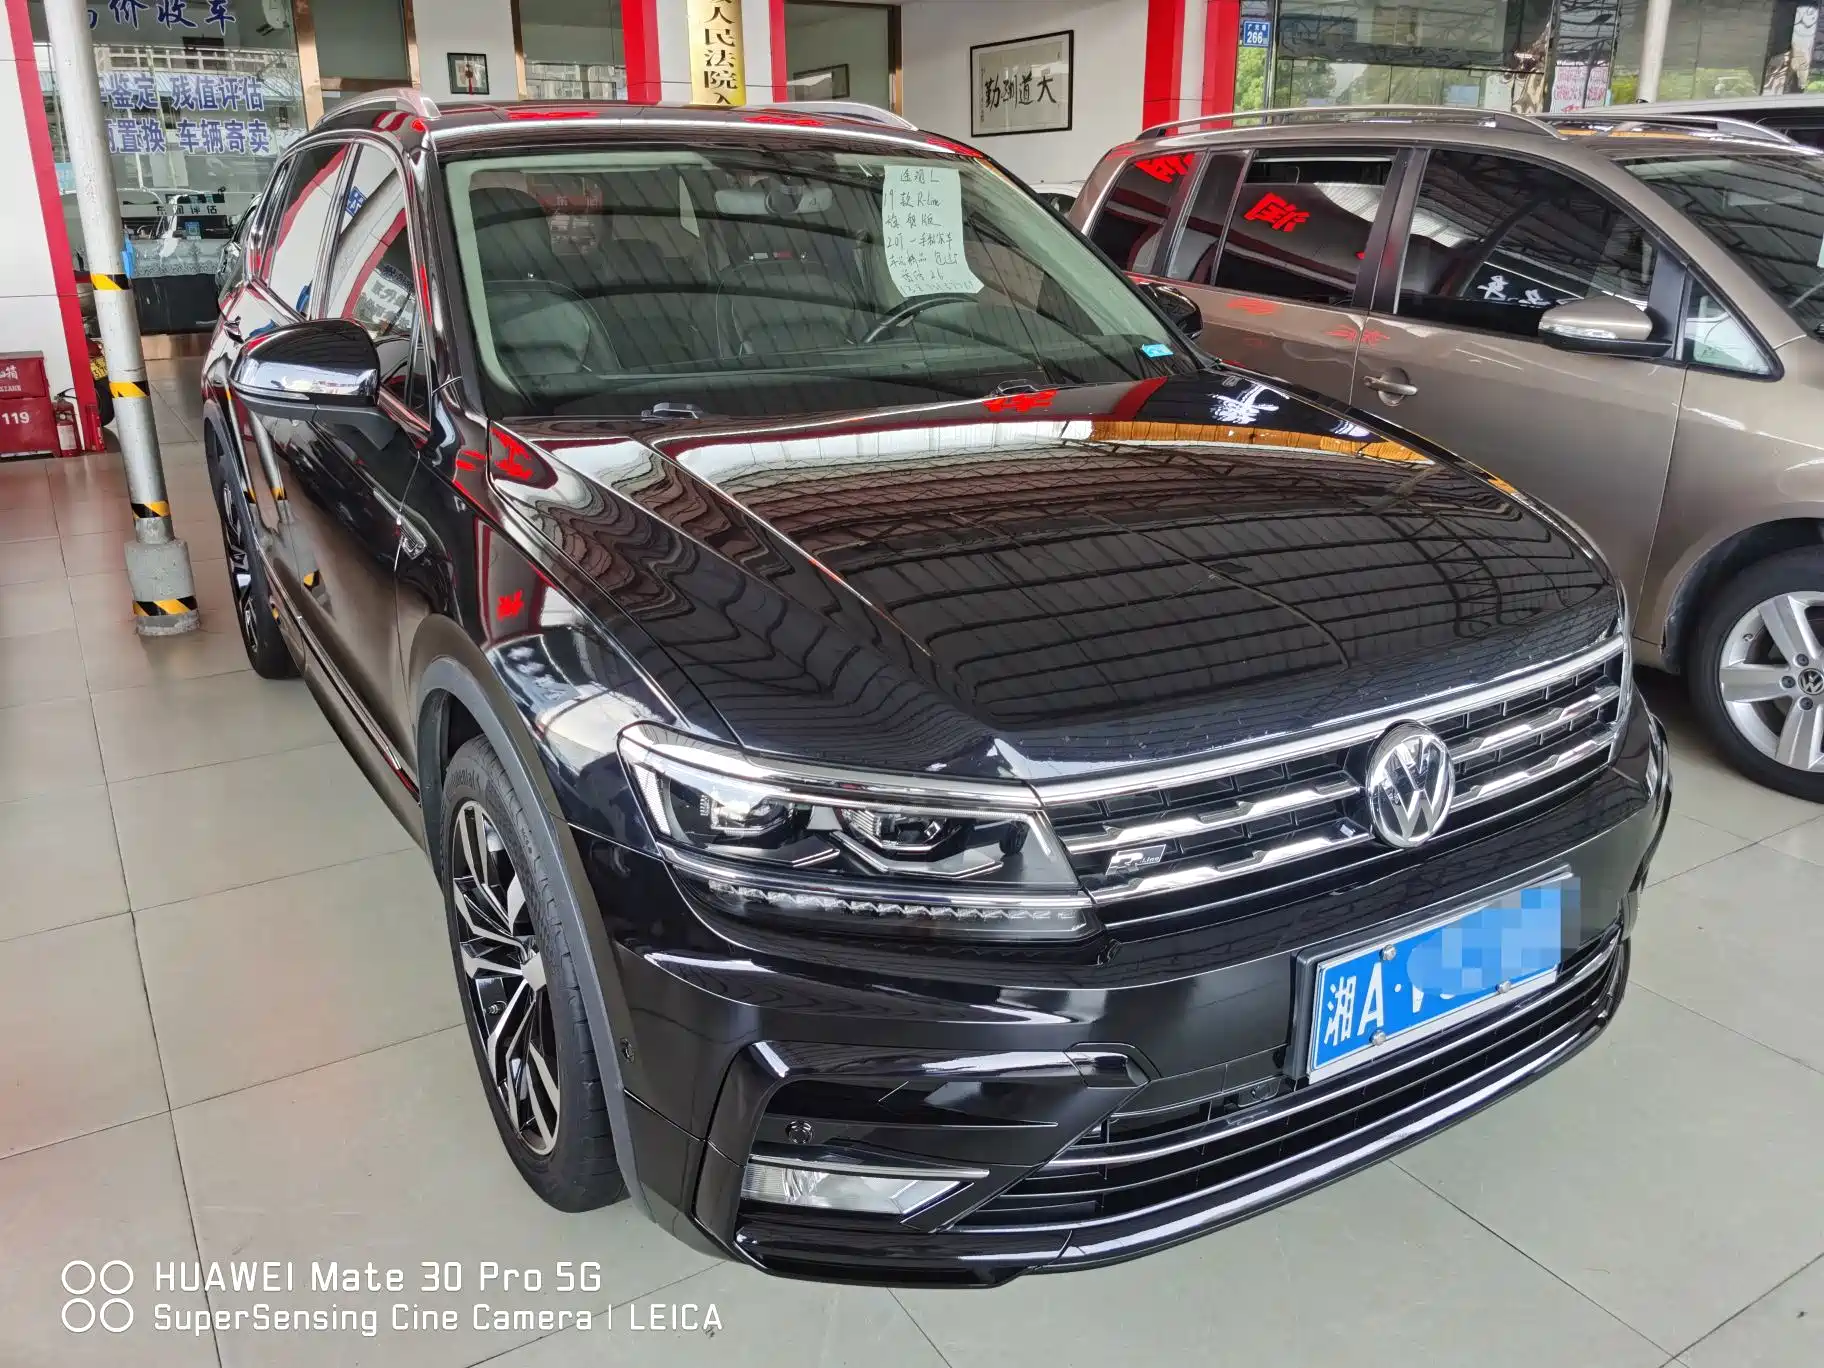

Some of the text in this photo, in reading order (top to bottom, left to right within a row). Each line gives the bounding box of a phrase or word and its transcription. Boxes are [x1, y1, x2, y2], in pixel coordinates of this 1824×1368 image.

[88, 0, 236, 34] 价收车
[1246, 31, 1263, 44] 266
[169, 75, 265, 111] 残值评估
[176, 119, 271, 153] 车辆寄卖
[930, 168, 941, 183] L
[1, 411, 30, 425] 119
